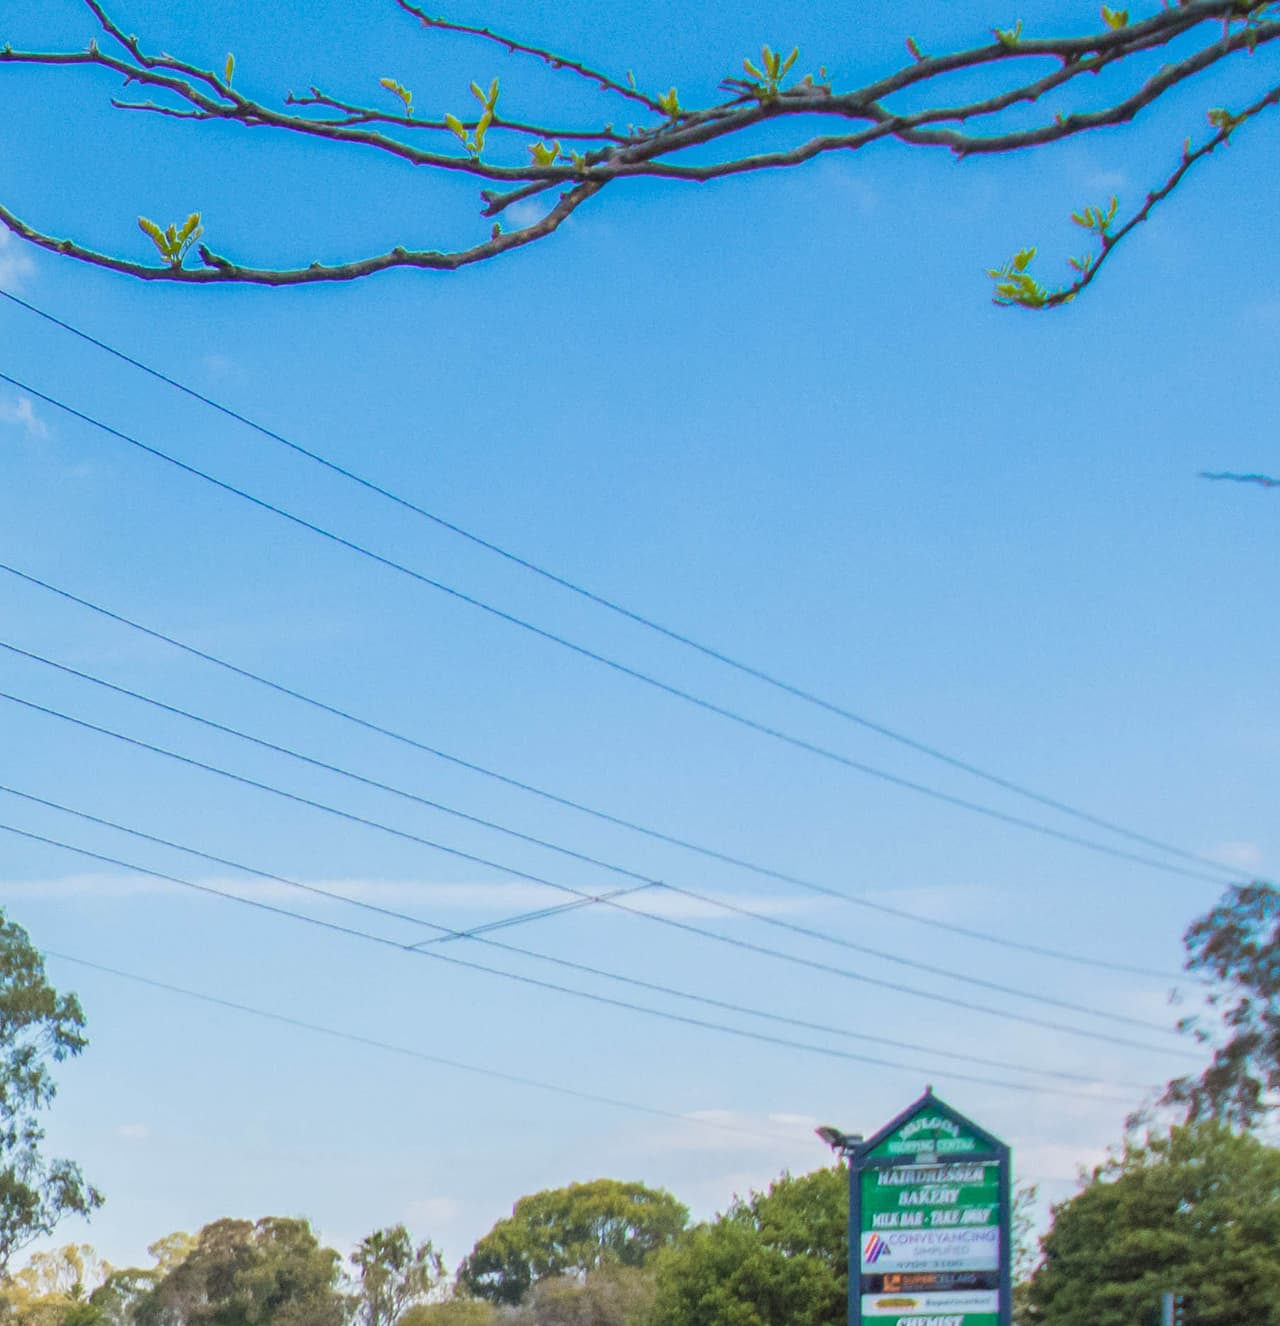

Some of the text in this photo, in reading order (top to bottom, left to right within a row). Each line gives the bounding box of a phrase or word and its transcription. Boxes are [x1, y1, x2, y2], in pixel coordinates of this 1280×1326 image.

[898, 1189, 960, 1206] BAKERY
[873, 1213, 899, 1227] MILK
[900, 1211, 924, 1226] BAR
[890, 1231, 995, 1246] CONVEYANCING
